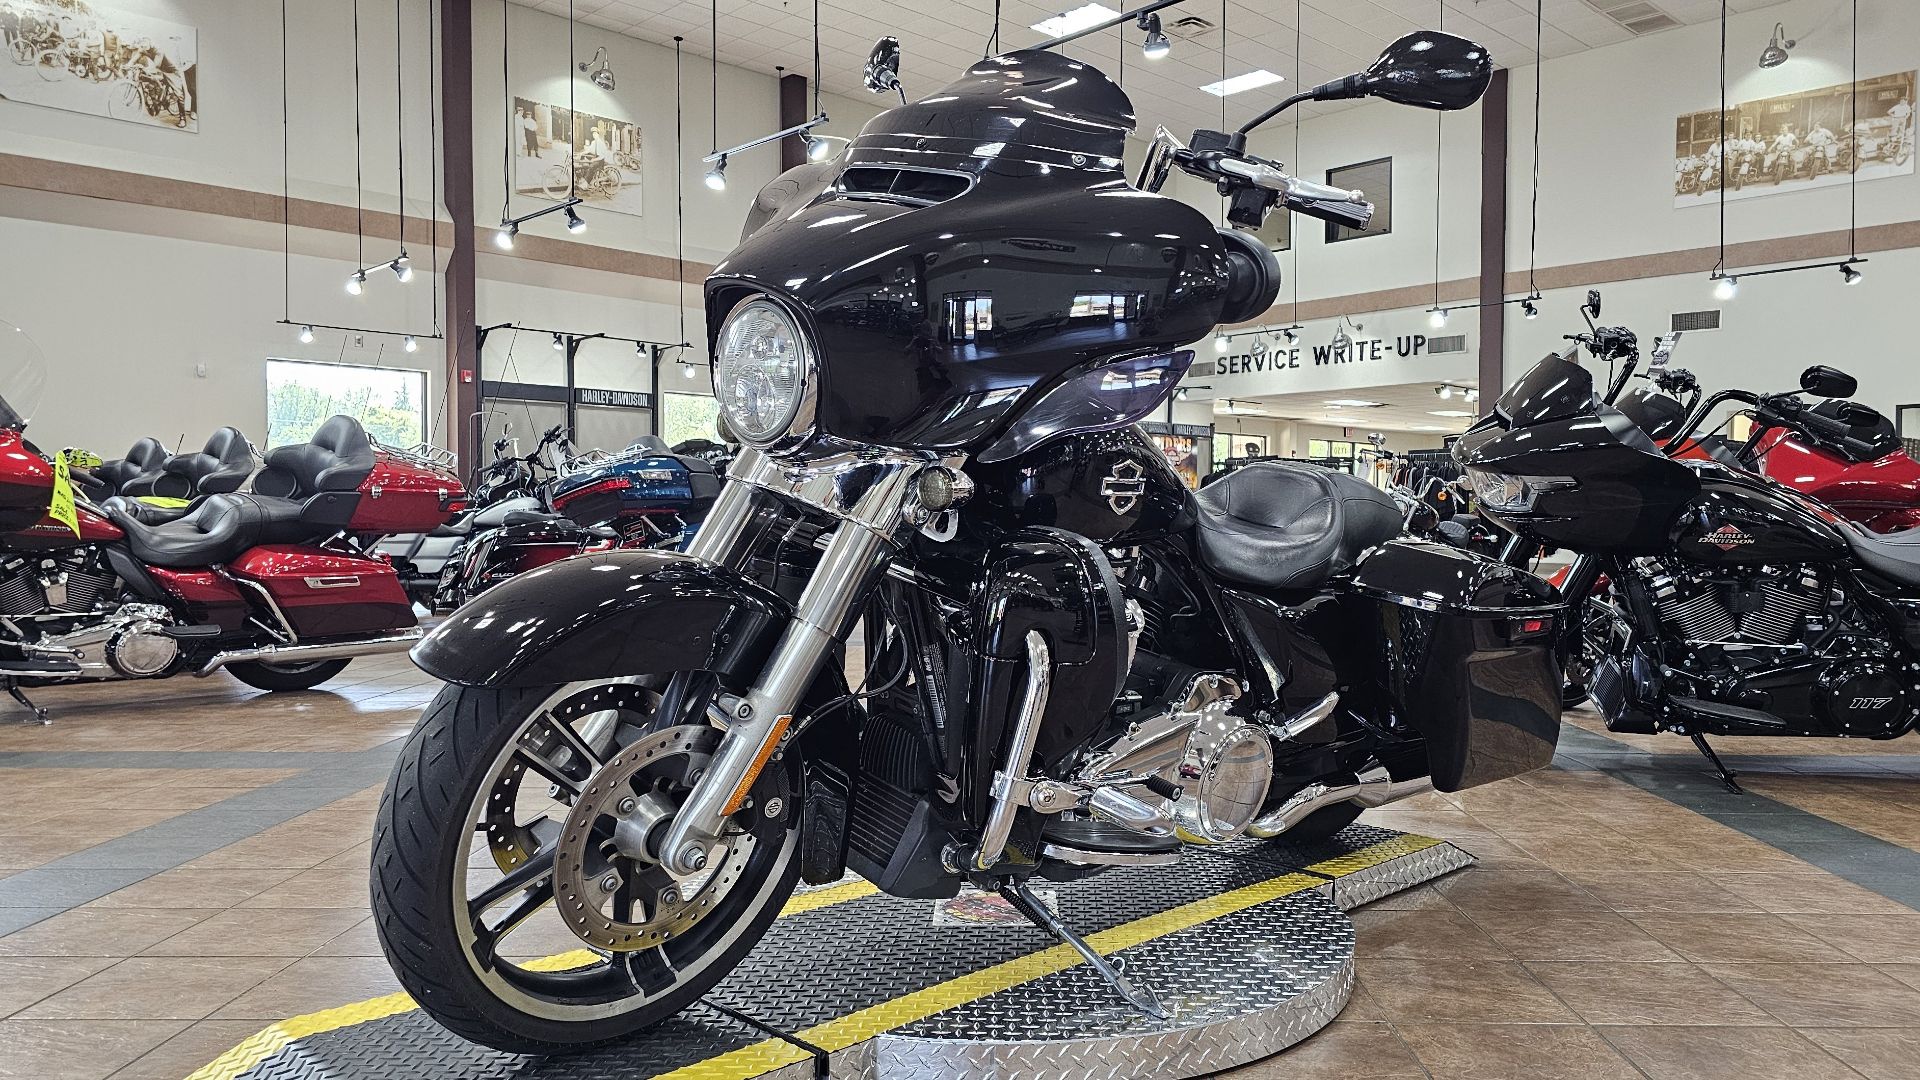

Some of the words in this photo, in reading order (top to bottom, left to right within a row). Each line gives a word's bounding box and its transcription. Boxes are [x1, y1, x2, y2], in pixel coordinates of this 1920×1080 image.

[1216, 348, 1300, 375] SERVICE
[1312, 334, 1426, 366] WRITE-UP
[581, 389, 648, 407] HARLEY-DAVIDSON
[1849, 697, 1893, 709] 117
